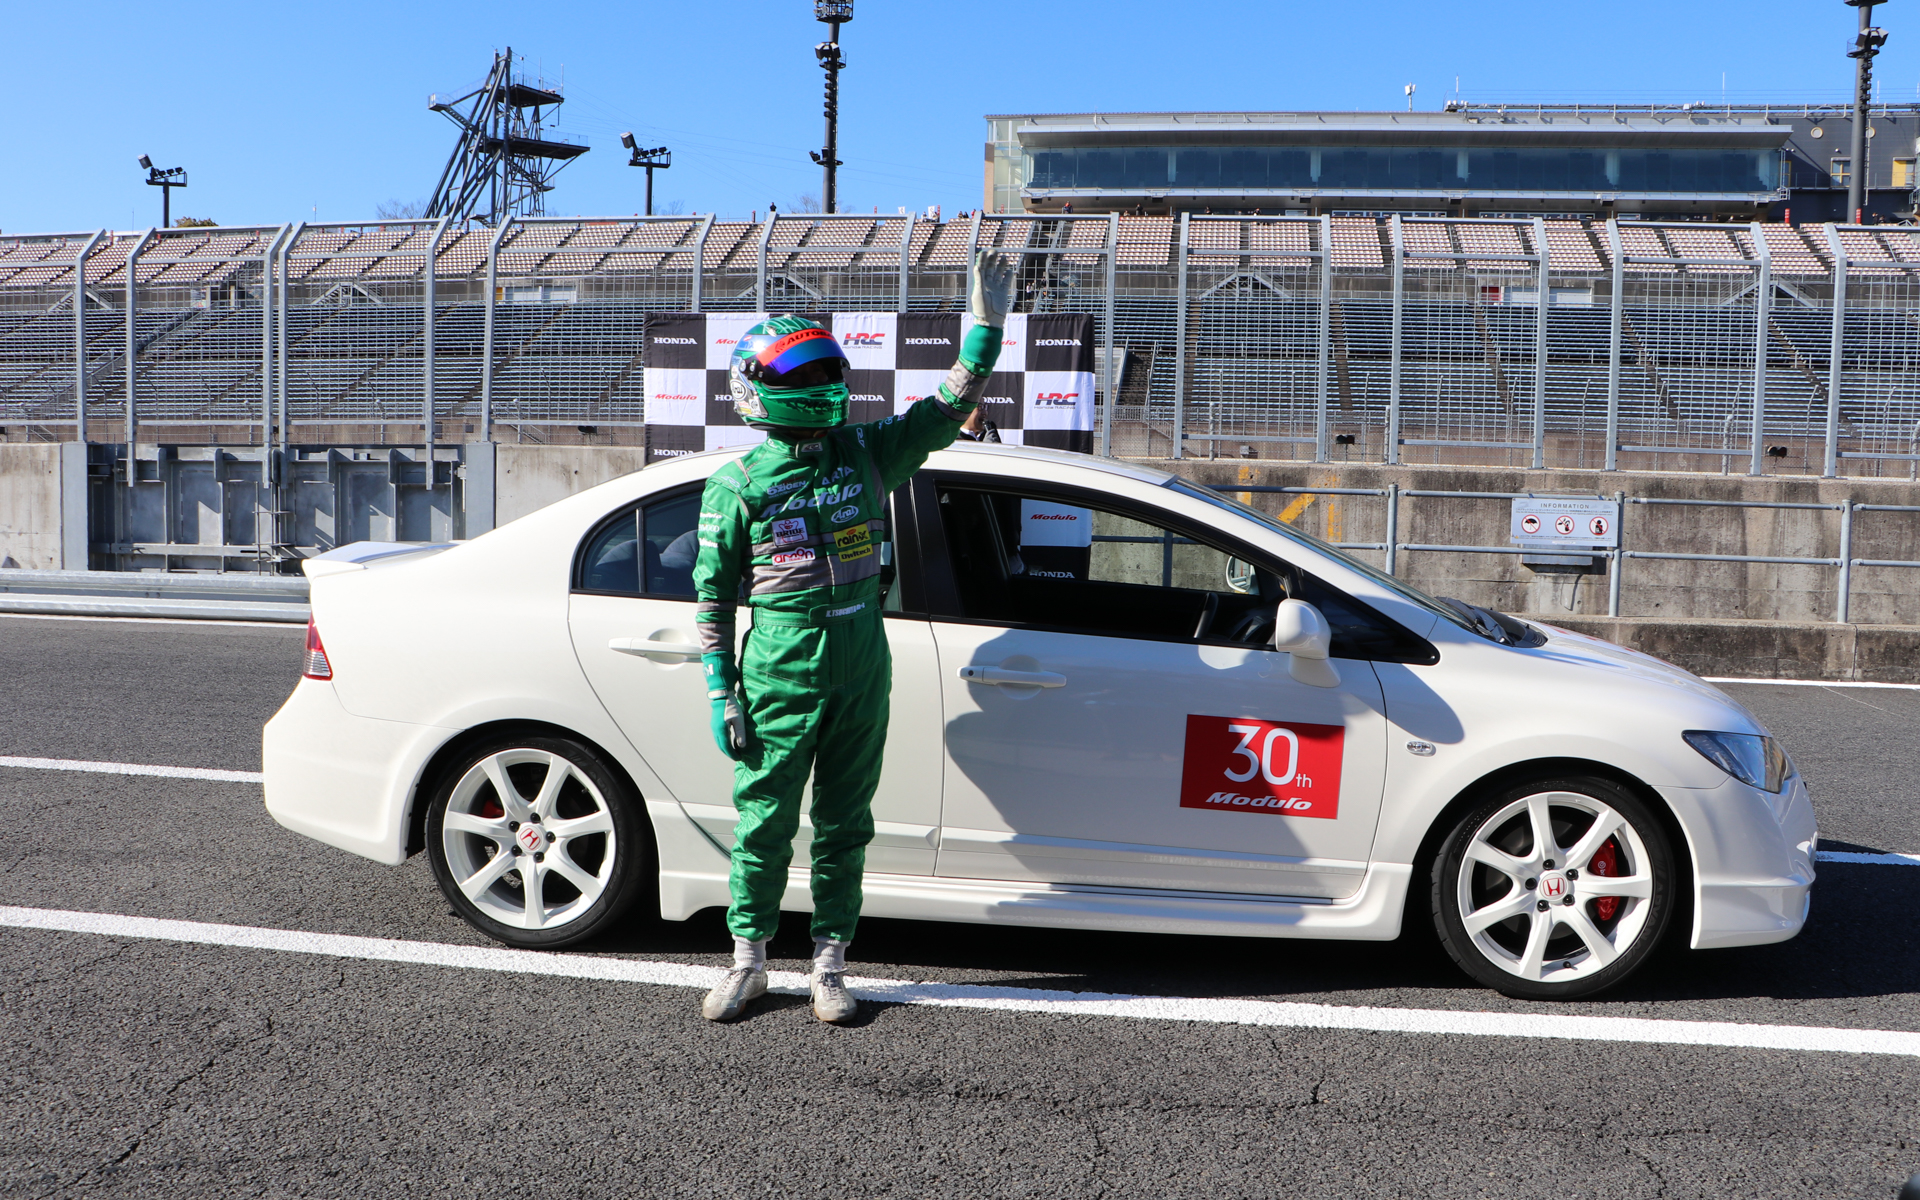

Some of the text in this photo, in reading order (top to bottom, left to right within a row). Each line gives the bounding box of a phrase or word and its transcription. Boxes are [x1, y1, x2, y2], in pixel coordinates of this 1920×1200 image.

[654, 337, 698, 345] HONDA
[843, 333, 885, 346] HRC
[849, 394, 885, 402] ONDA
[983, 396, 1015, 404] NDA
[1035, 393, 1079, 405] HRC
[822, 466, 854, 485] ARTA
[760, 484, 863, 518] Modulo
[1030, 513, 1077, 521] Modulo
[776, 527, 805, 538] BRIDE
[774, 548, 814, 564] amon
[1205, 791, 1313, 811] Modulo
